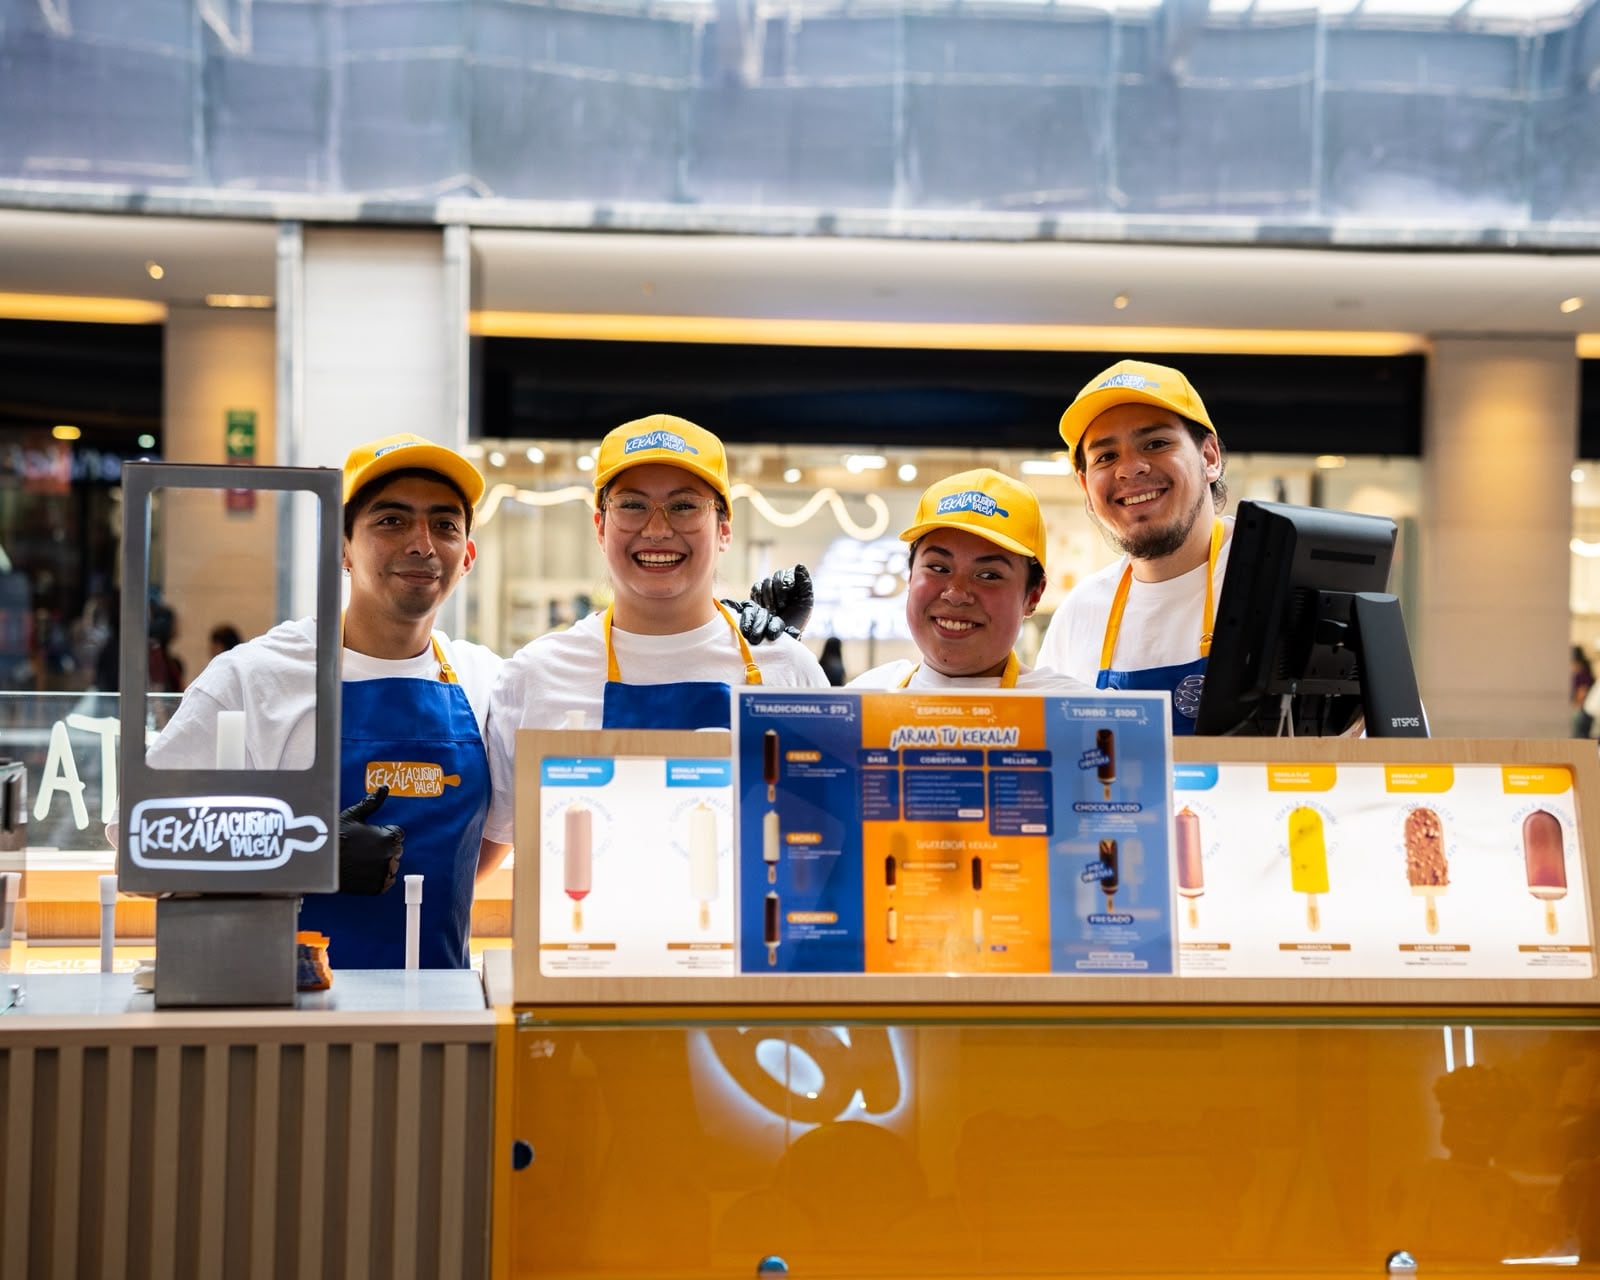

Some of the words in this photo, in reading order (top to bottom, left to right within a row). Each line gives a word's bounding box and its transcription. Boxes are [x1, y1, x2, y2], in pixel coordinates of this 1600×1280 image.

[753, 704, 822, 714] TRADICIONAL
[829, 705, 848, 715] $75
[917, 706, 964, 716] ESPECIAL
[1072, 708, 1107, 717] TURBO
[941, 728, 958, 744] TU
[867, 756, 889, 764] BASE
[920, 756, 968, 765] COBERTURA
[1002, 757, 1038, 766] RELLENO
[1074, 803, 1141, 813] CHOCOLATUDO
[1090, 914, 1132, 924] FRESADO
